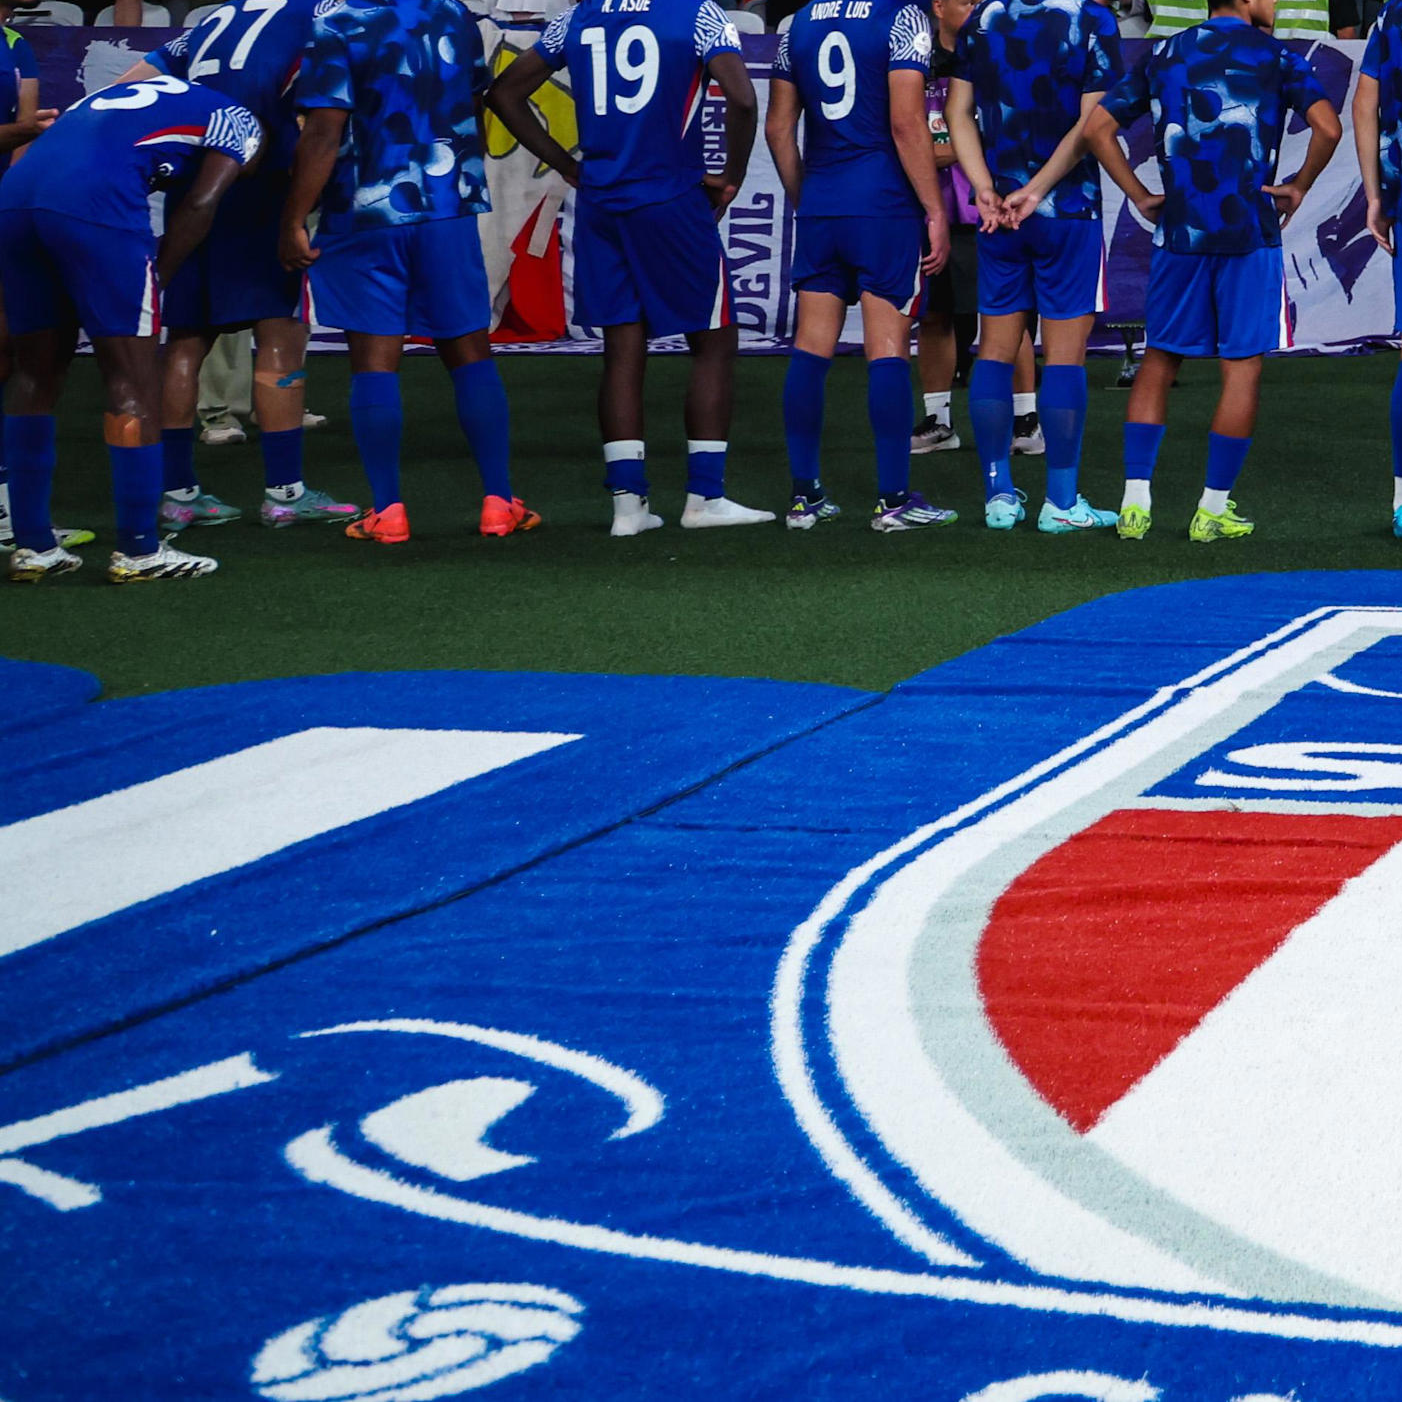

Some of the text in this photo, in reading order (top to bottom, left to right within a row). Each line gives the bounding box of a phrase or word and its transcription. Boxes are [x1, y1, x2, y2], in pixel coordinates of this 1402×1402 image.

[811, 0, 872, 21] ANDRE LUIS
[580, 24, 661, 116] 19
[818, 30, 857, 121] 9
